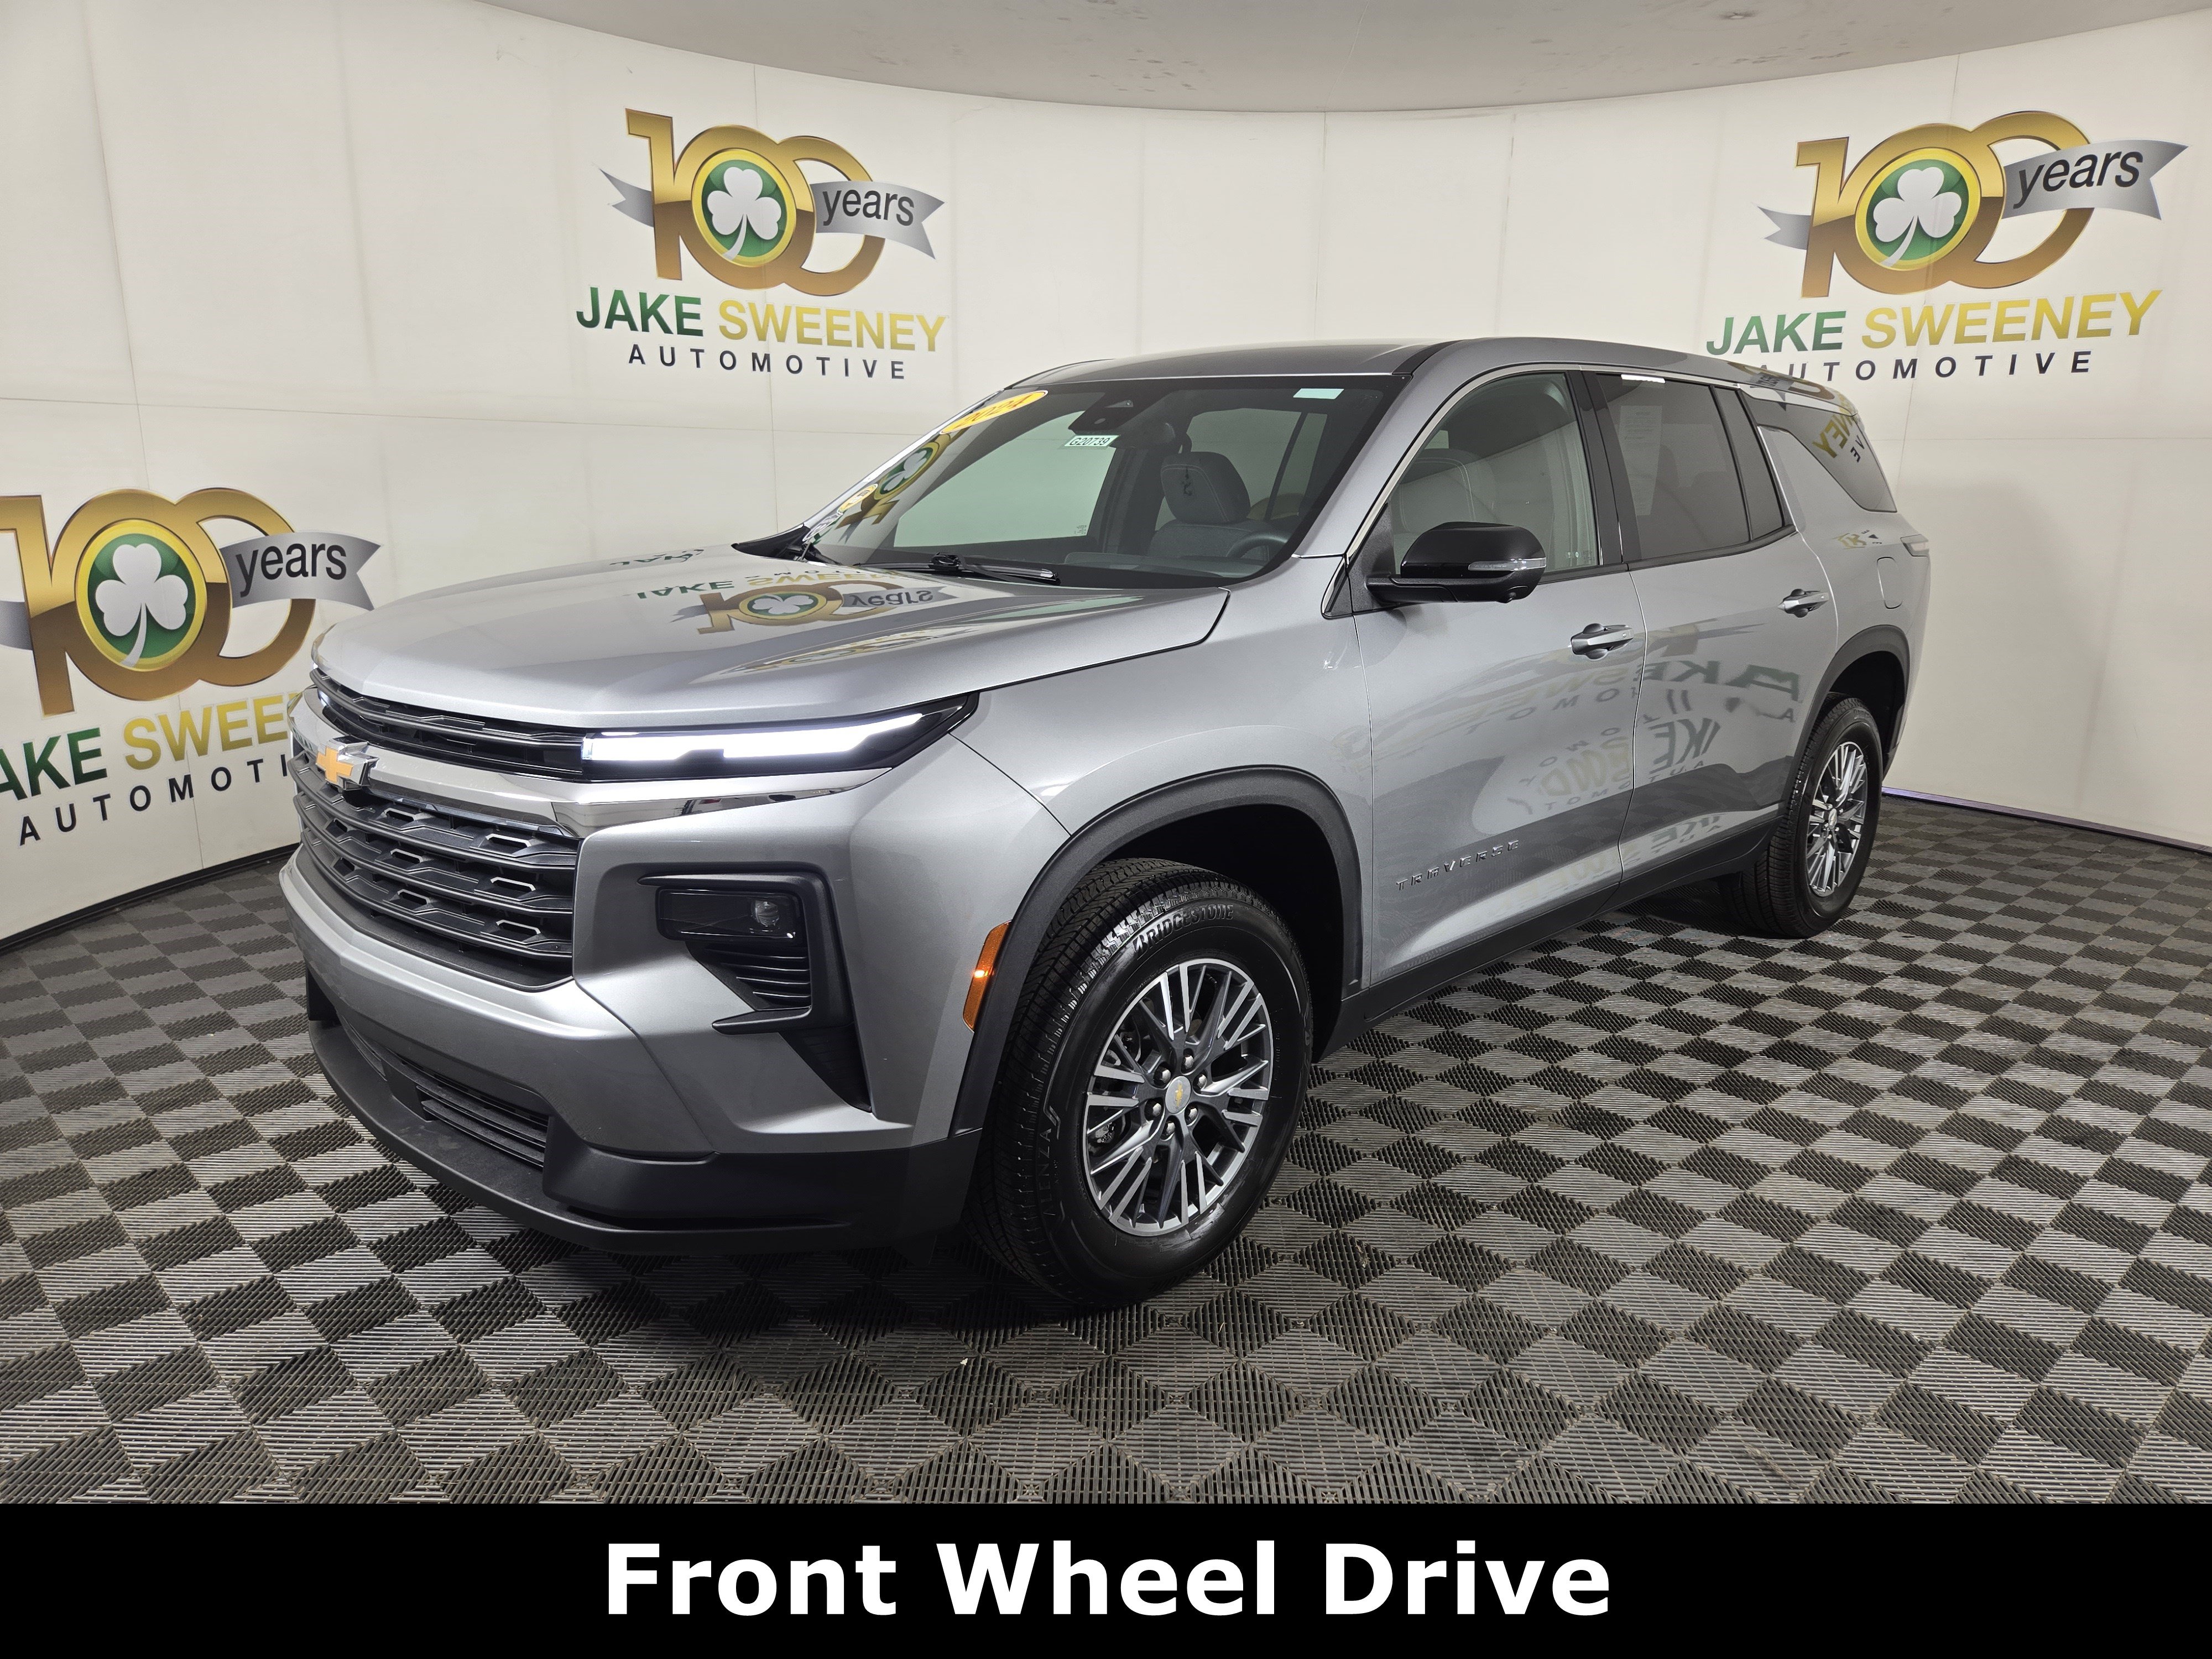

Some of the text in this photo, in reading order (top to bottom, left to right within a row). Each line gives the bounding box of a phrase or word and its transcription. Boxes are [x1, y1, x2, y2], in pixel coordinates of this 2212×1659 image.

[822, 189, 915, 227] years
[2012, 150, 2144, 211] years
[576, 286, 947, 353] JAKE SWEENEY
[1706, 289, 2163, 356] JAKE SWEENEY
[628, 343, 905, 380] AUTOMOTIVE
[952, 394, 1034, 430] 2024
[1069, 437, 1110, 446] G20739
[235, 542, 347, 598] years
[0, 692, 302, 801] AKE SWEE
[19, 754, 288, 846] AUTOMOTI
[1396, 840, 1520, 890] TRAVERSE
[1133, 904, 1234, 961] BRIDGESTONE
